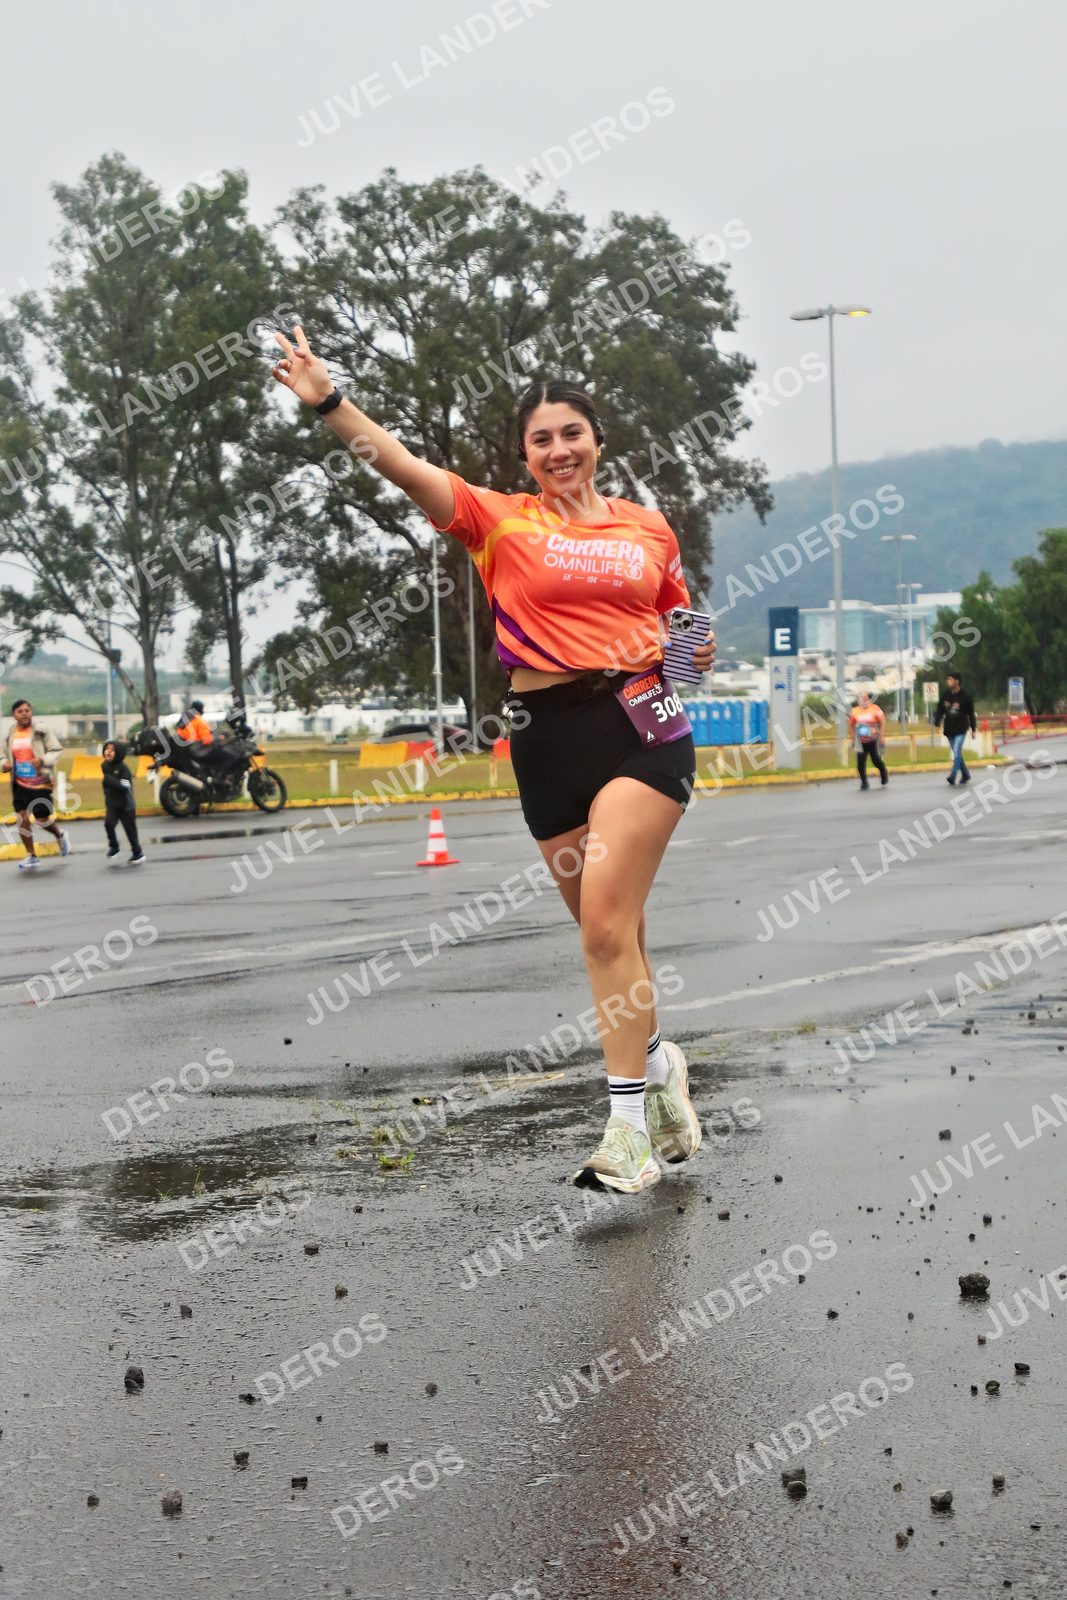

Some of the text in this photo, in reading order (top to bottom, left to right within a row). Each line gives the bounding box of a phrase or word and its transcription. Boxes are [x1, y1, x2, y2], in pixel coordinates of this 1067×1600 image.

[547, 533, 645, 563] CARRERA
[544, 553, 624, 577] OMNILIFE
[774, 627, 791, 651] E
[623, 673, 660, 700] CARRERA
[629, 688, 657, 707] OMNILIFE
[651, 692, 683, 723] 308
